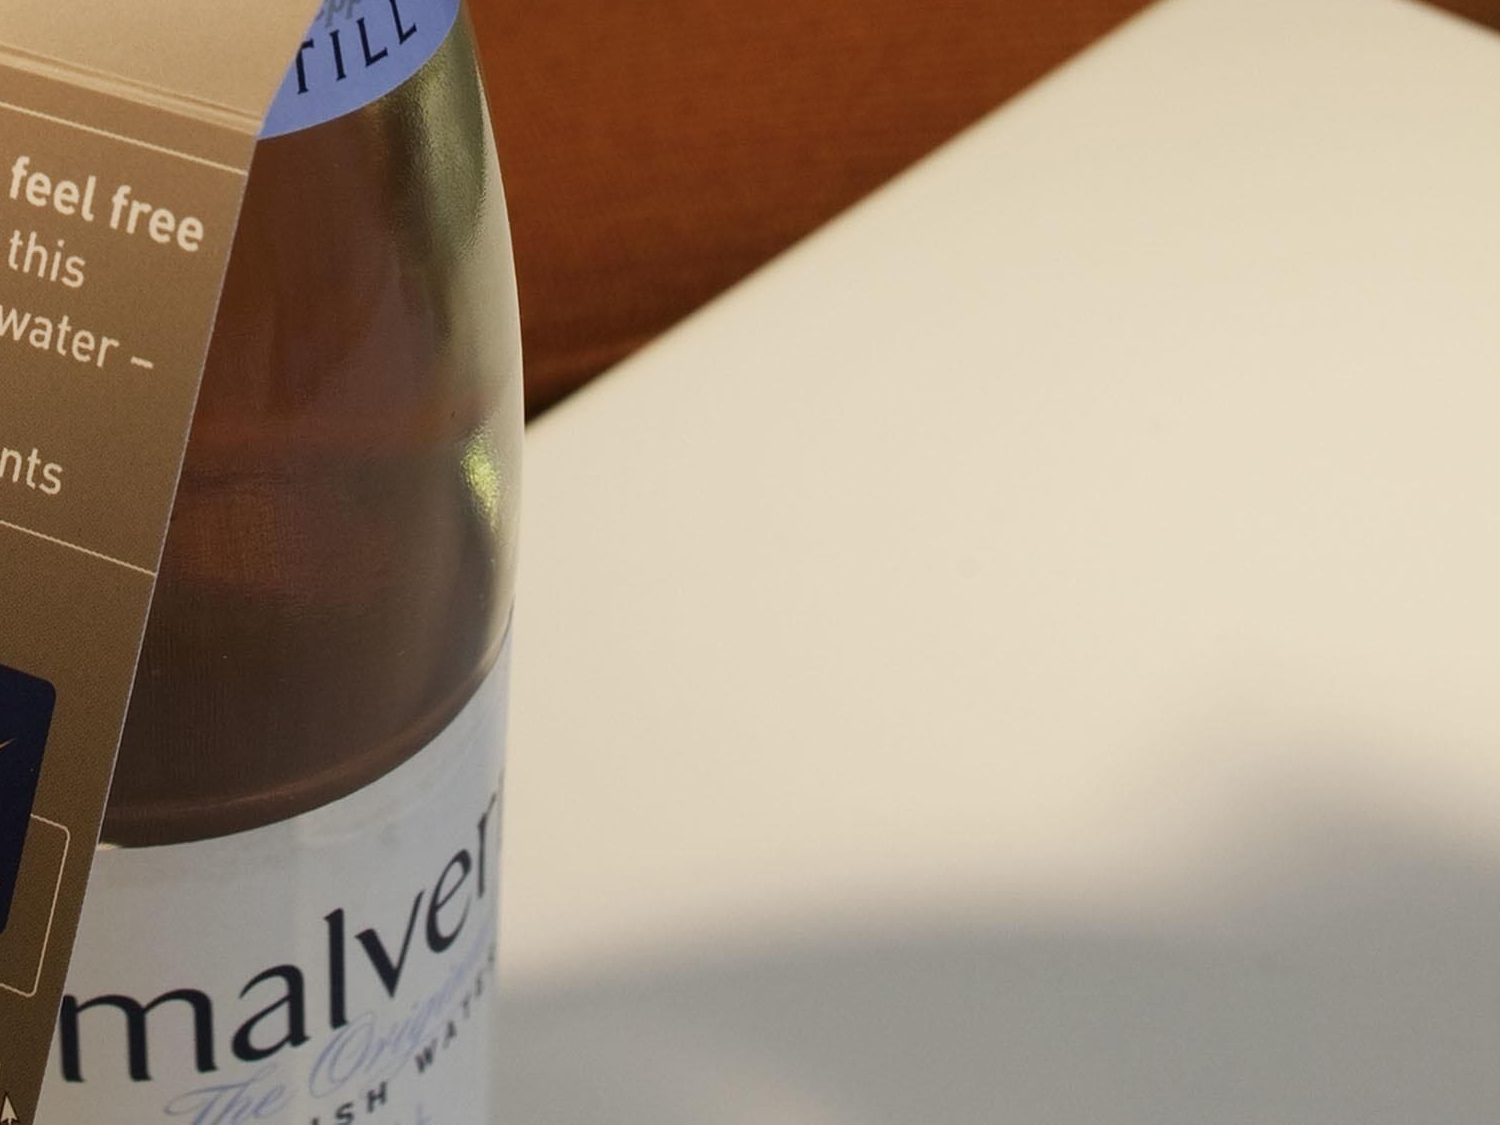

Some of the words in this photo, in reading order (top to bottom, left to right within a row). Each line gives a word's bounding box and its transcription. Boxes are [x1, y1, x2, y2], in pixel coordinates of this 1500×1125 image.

[8, 156, 97, 222] feel
[109, 185, 204, 252] free
[7, 229, 86, 289] this
